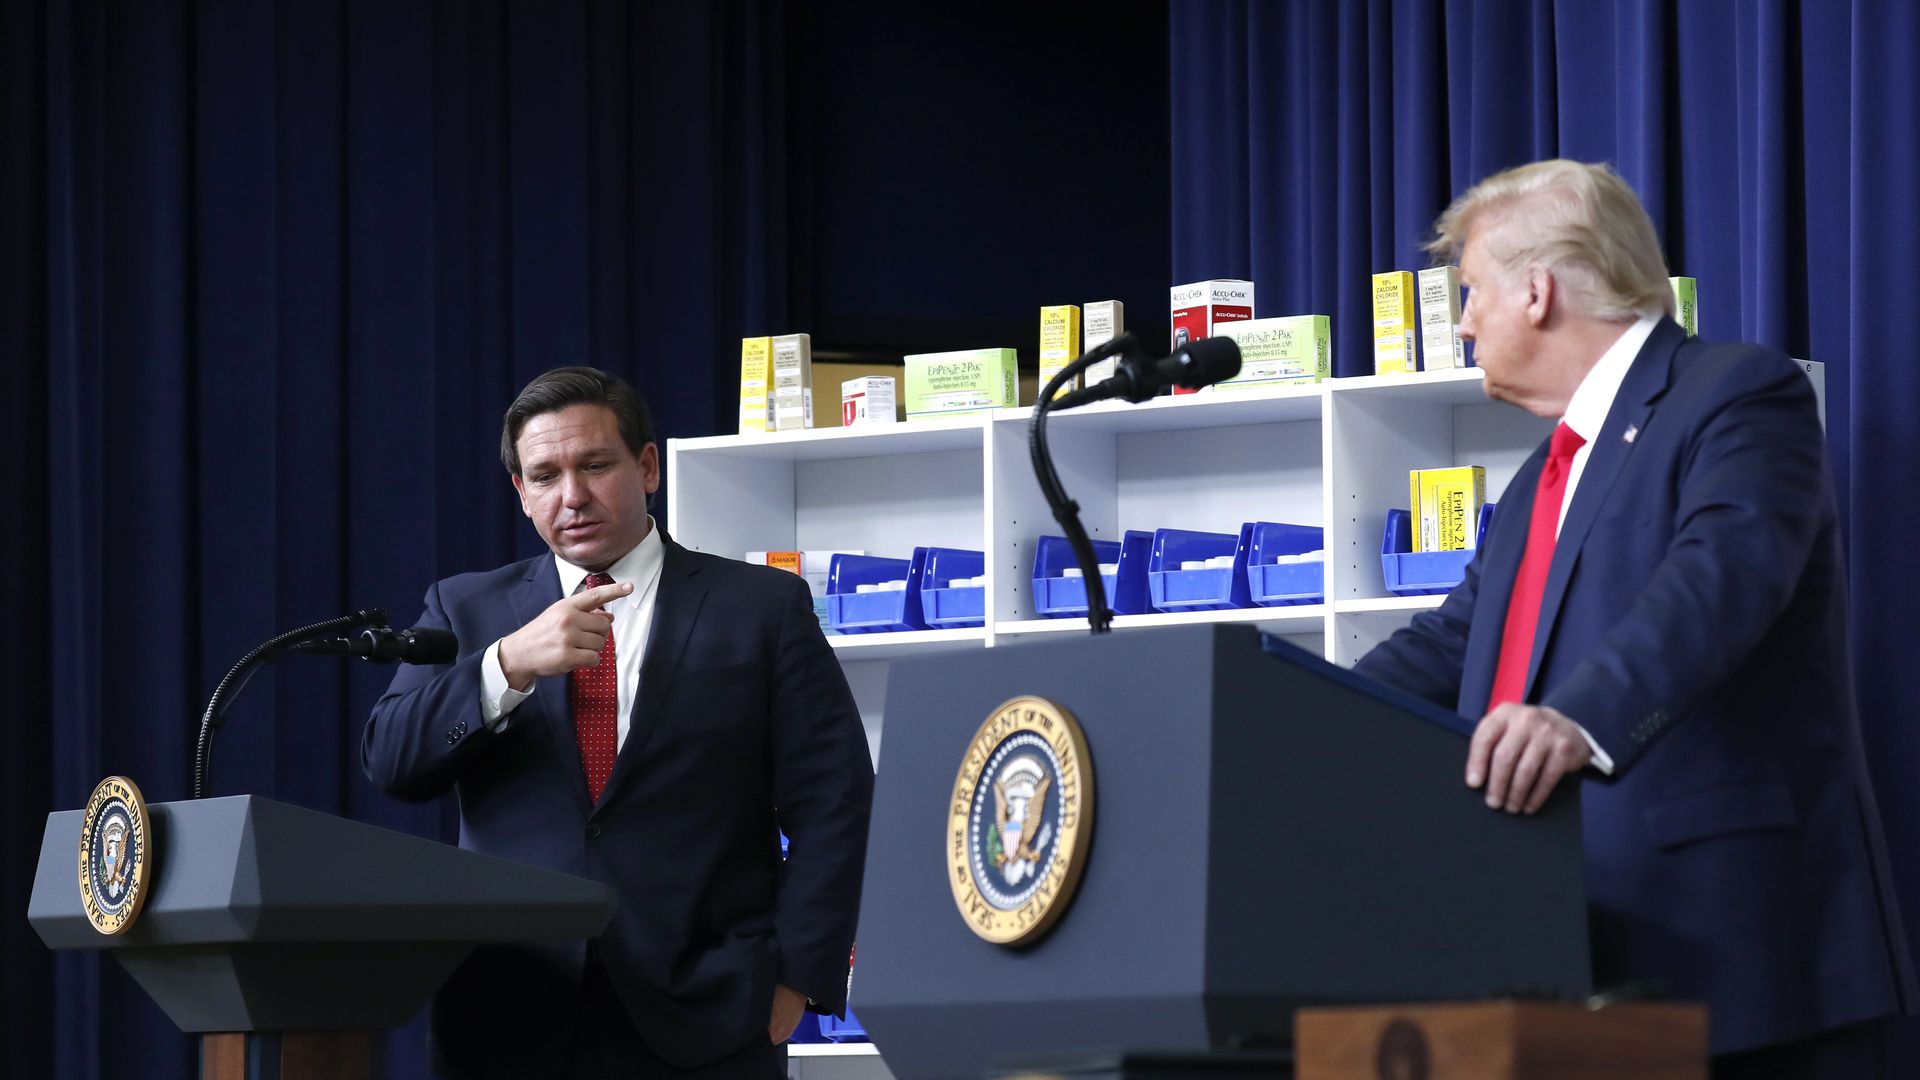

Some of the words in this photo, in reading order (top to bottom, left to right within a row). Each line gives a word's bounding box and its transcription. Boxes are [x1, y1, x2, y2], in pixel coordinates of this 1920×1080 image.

[1173, 289, 1203, 301] ACCU-CHEK
[1212, 290, 1246, 298] ACCU-CHEK
[1376, 292, 1398, 300] CHLORIDE
[1024, 710, 1036, 723] OF
[1038, 712, 1055, 731] THE
[955, 708, 1021, 817] PRESIDENT
[113, 784, 120, 793] OF
[1055, 732, 1076, 829] UNITED
[121, 787, 130, 802] THE
[81, 781, 114, 852] PRESIDENT
[130, 799, 143, 865] UNITED
[955, 829, 964, 858] THE
[957, 865, 967, 884] OF
[83, 883, 90, 895] OF
[1017, 856, 1067, 929] STATES
[88, 899, 105, 927] SEAL
[115, 879, 140, 927] STATES
[964, 884, 996, 930] SEAL
